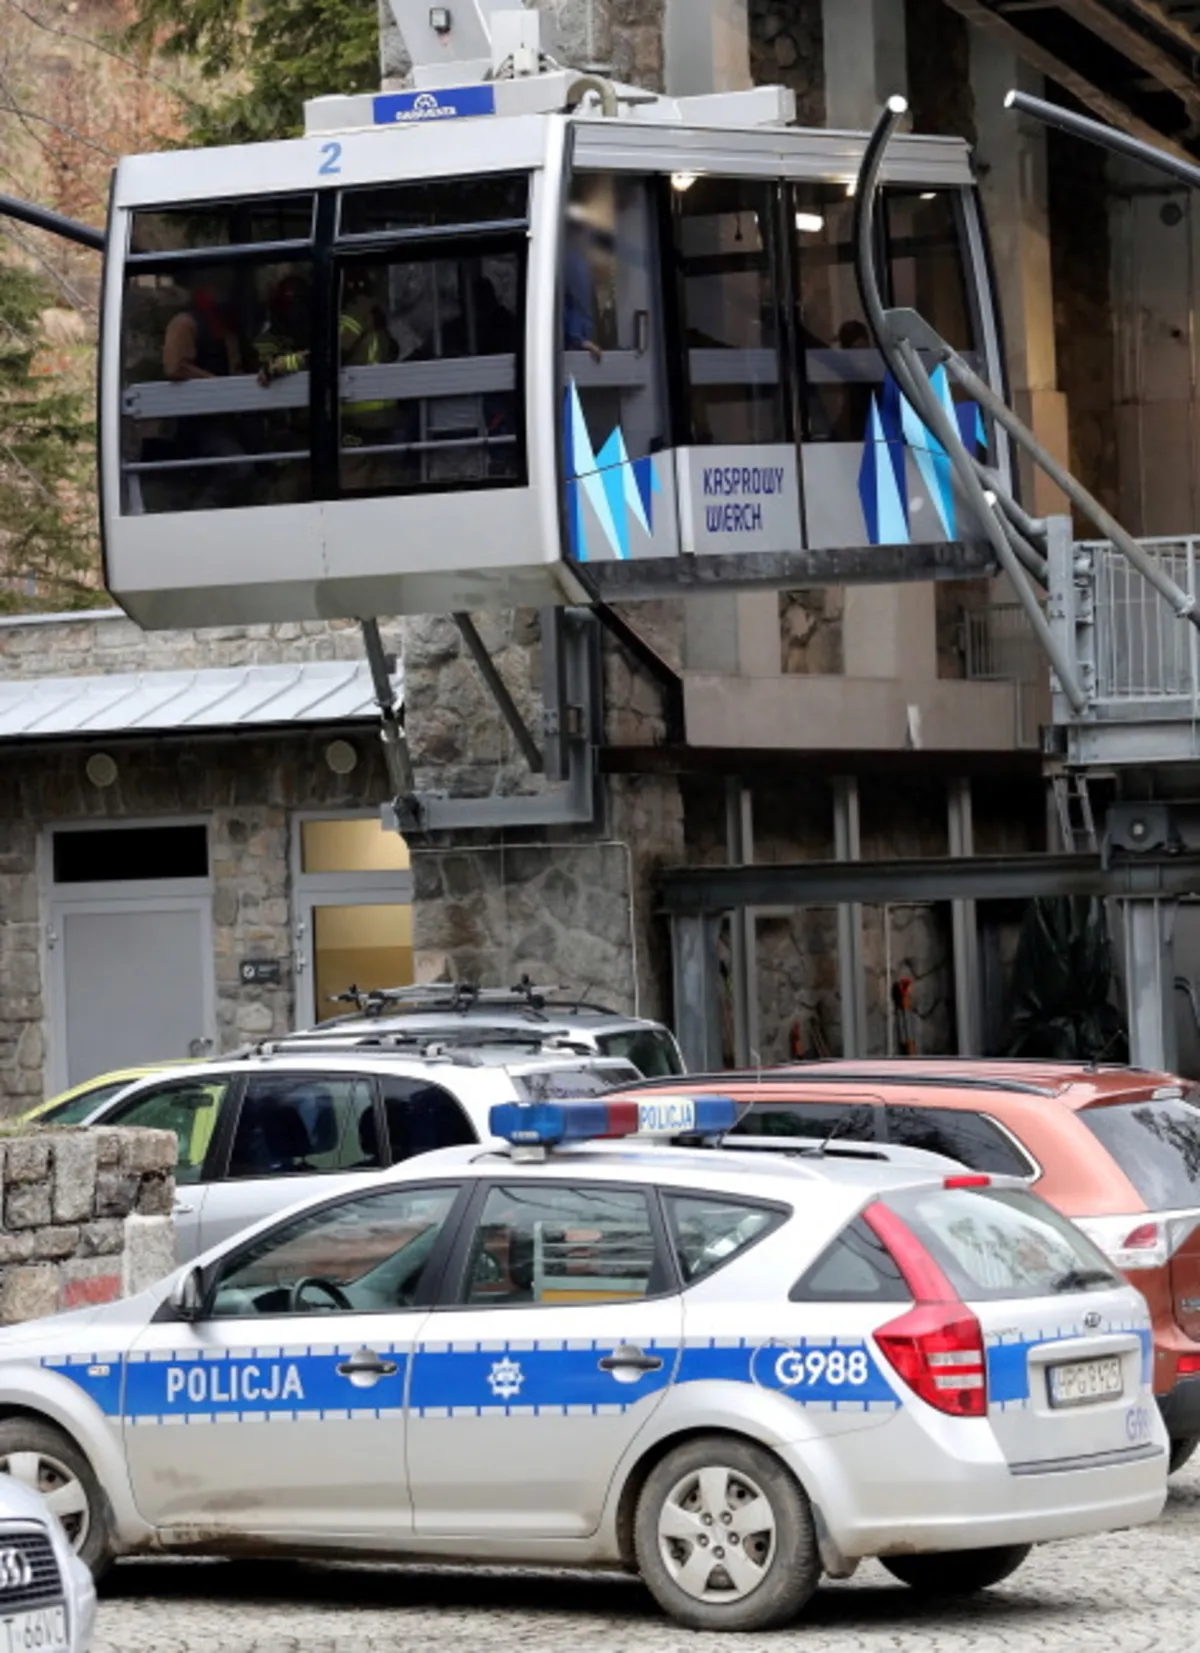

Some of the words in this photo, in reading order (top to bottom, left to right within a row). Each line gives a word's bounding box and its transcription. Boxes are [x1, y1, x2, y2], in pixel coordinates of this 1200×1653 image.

[318, 141, 342, 176] 2
[703, 466, 784, 496] KASPROWY
[704, 502, 763, 533] WIERCH
[639, 1104, 693, 1131] POLICJA
[166, 1364, 305, 1404] POLICJA
[775, 1350, 869, 1387] G988
